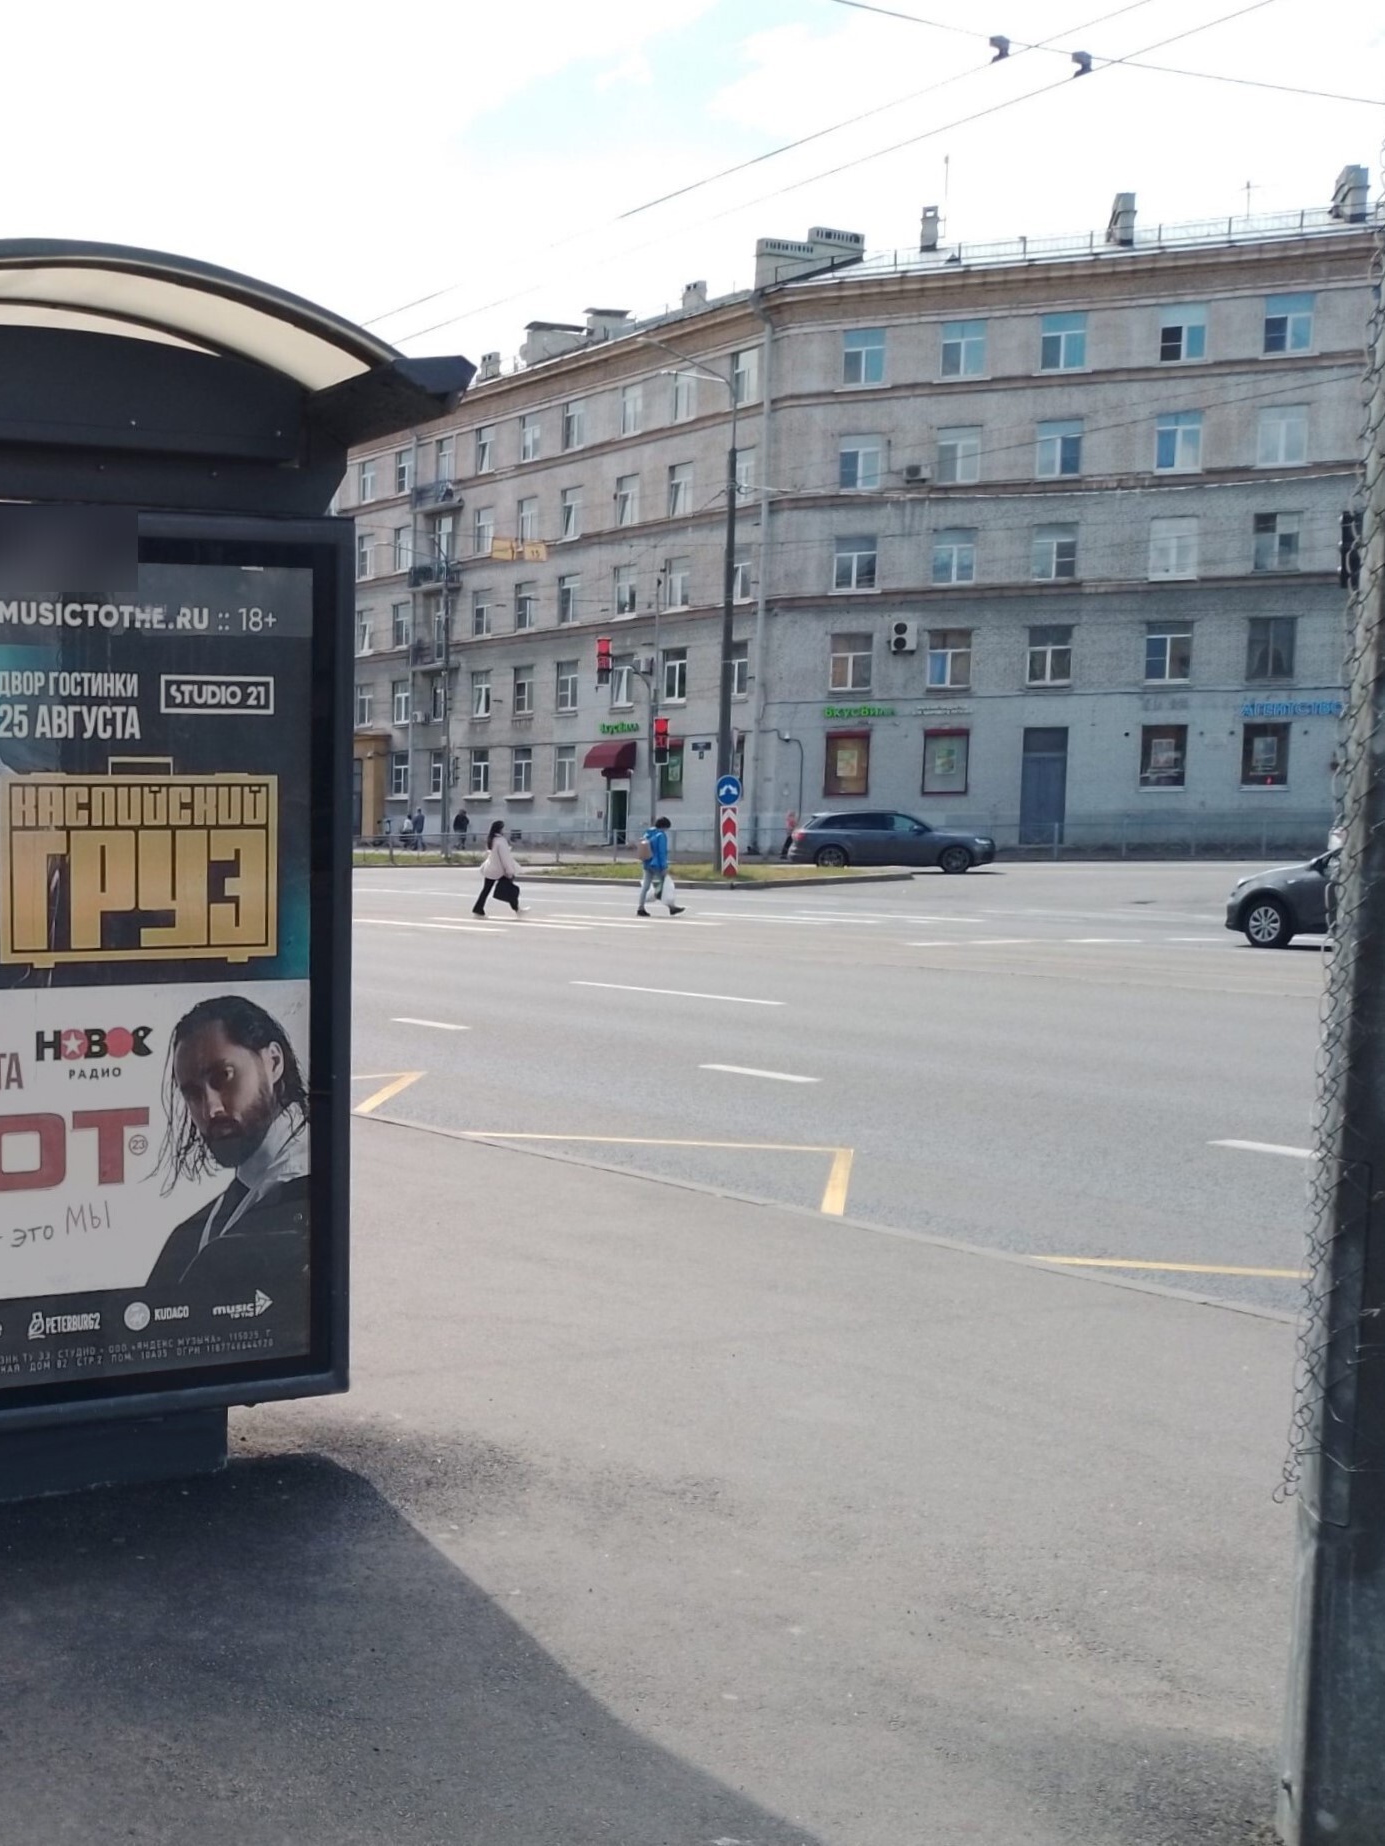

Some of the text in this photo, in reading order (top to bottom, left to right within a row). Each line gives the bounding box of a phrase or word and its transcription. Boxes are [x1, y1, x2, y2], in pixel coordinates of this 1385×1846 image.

[237, 607, 277, 632] 18+
[48, 671, 138, 698] ГОСТИНКИ
[169, 684, 265, 706] STUDIO 21
[34, 704, 142, 740] АВГУСТА
[11, 785, 268, 827] КАСПИЙСКИЙ
[11, 828, 267, 950] ГРУЗ
[68, 1066, 122, 1081] РАДИО
[11, 1224, 55, 1248] это
[65, 1200, 111, 1236] МЫ
[45, 1312, 101, 1335] PETERBURG2
